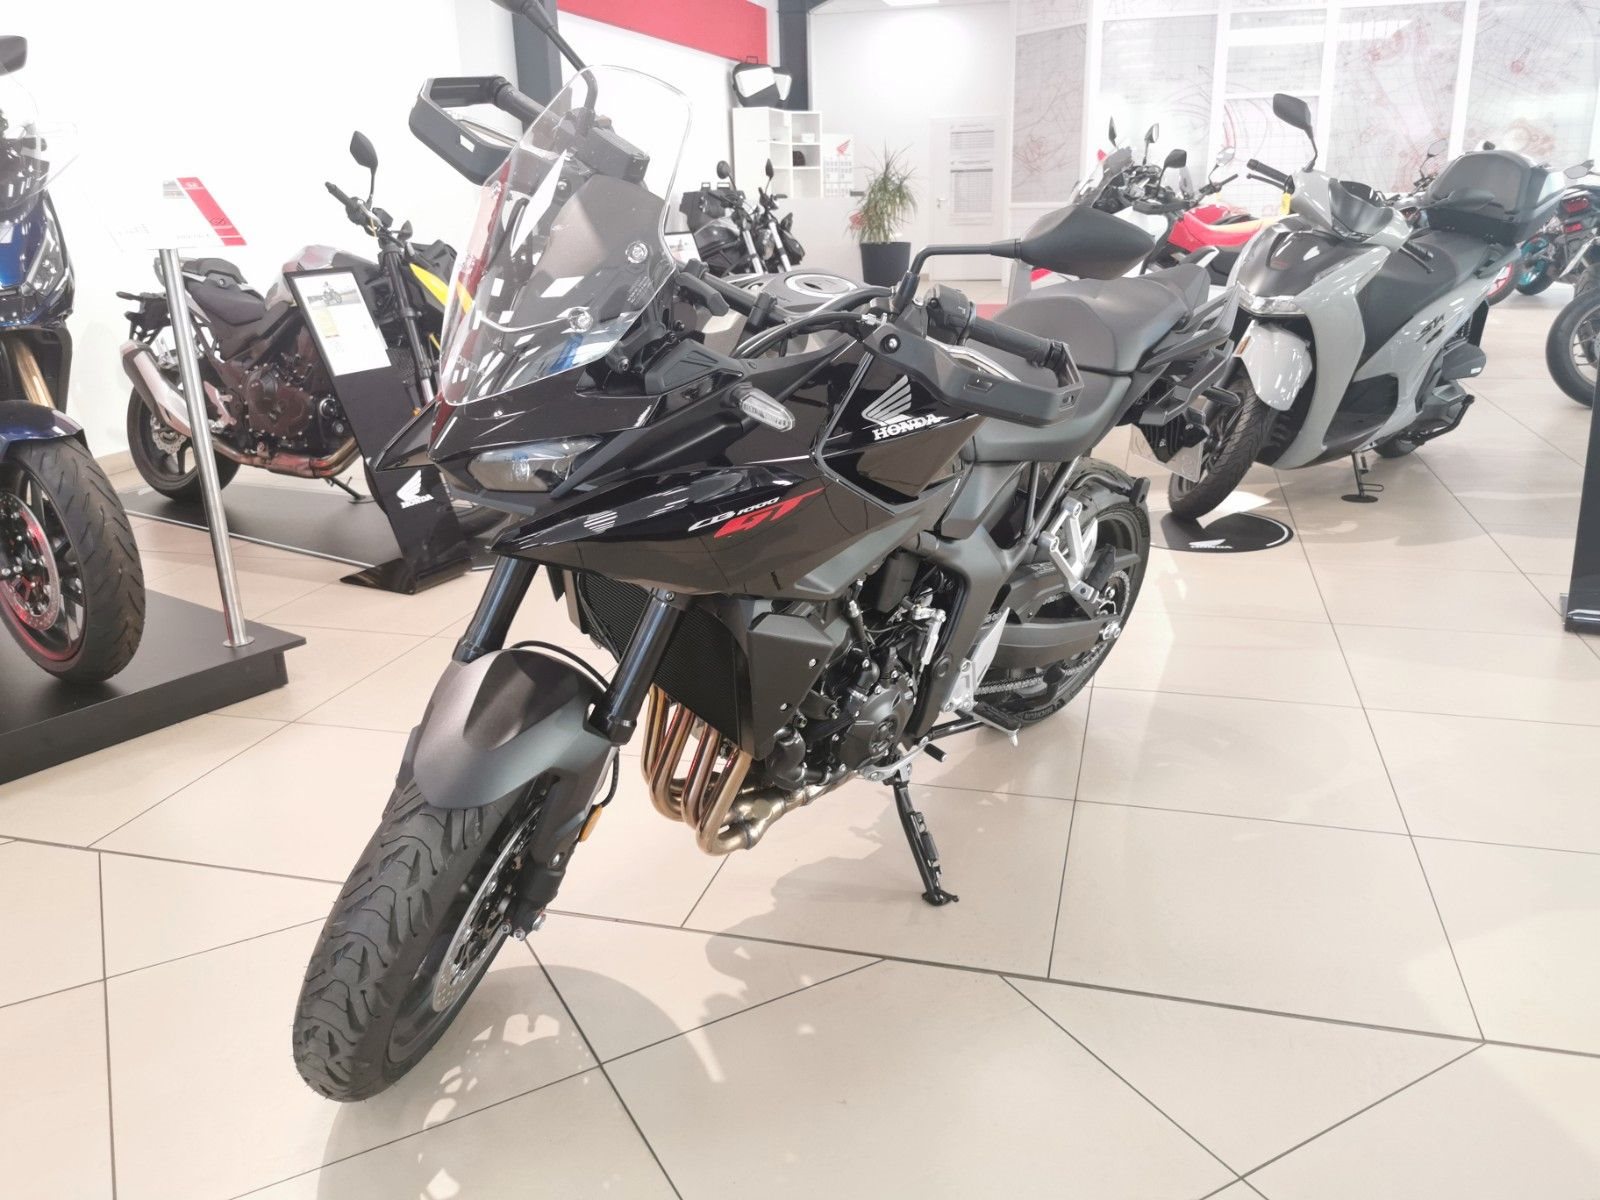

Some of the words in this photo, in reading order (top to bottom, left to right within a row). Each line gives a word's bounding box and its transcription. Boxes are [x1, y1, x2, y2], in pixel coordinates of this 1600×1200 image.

[872, 413, 949, 441] HONDA
[400, 494, 434, 509] HONDA
[713, 487, 826, 539] GT
